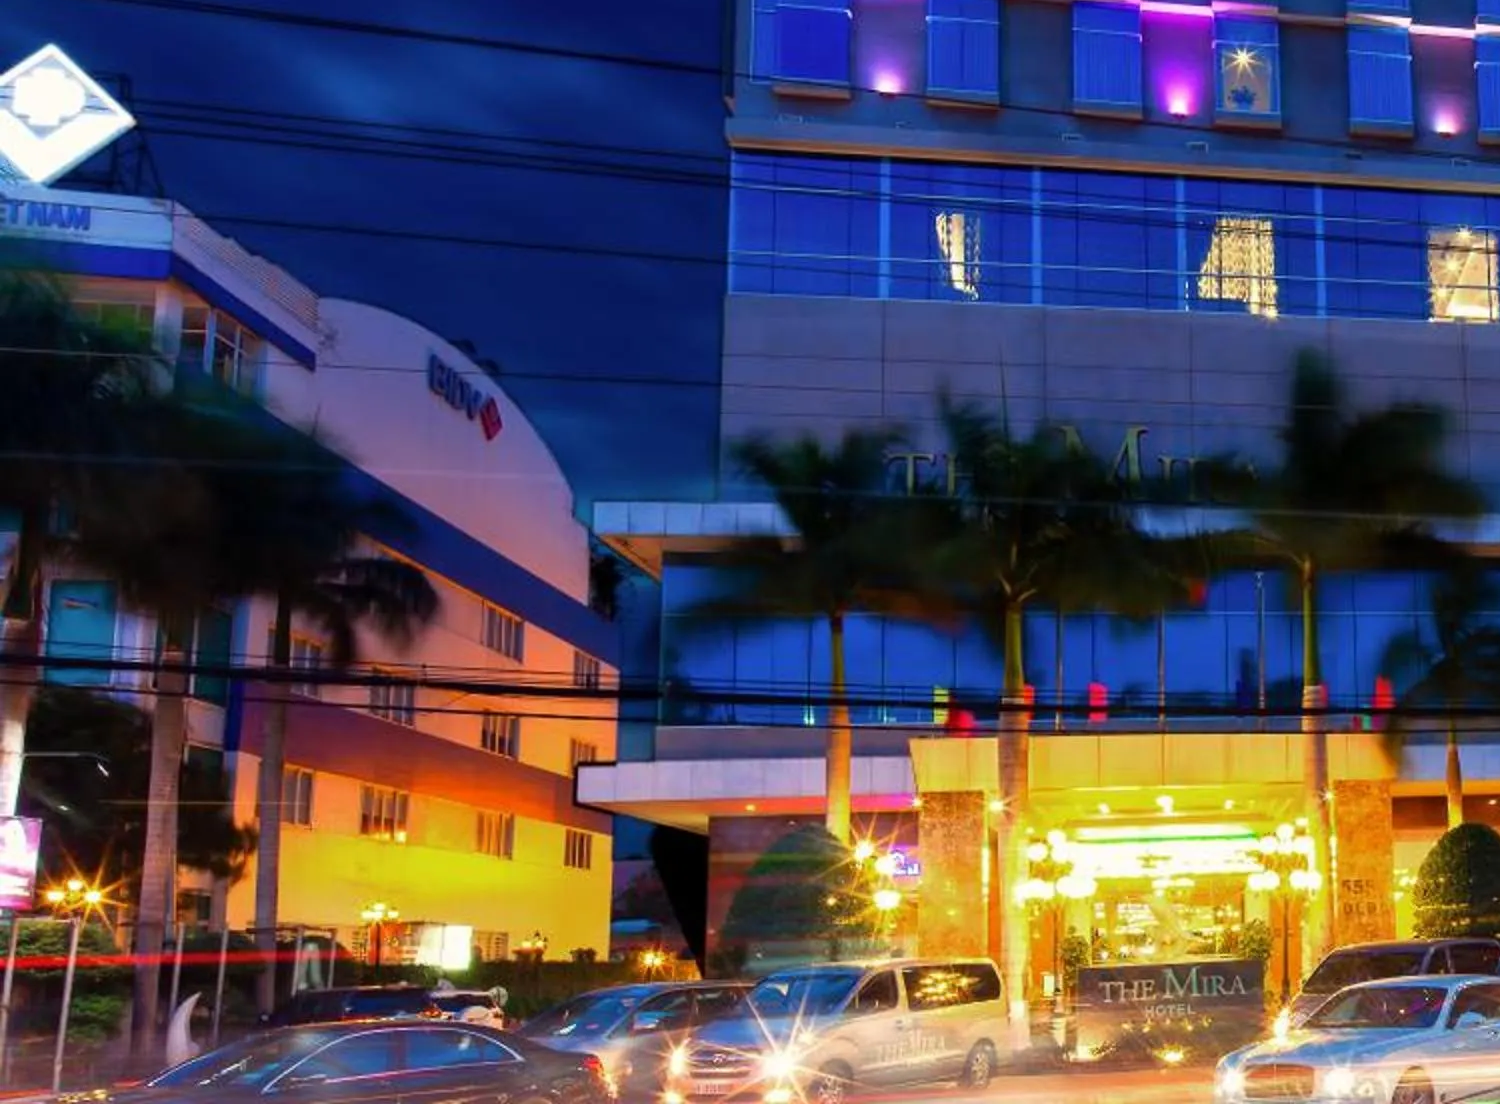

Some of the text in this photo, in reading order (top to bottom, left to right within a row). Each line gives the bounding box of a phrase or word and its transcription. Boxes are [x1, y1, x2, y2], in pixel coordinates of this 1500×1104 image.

[26, 202, 91, 231] NAM
[1099, 966, 1248, 1003] THE MIRA
[1144, 1003, 1197, 1018] HOTEL
